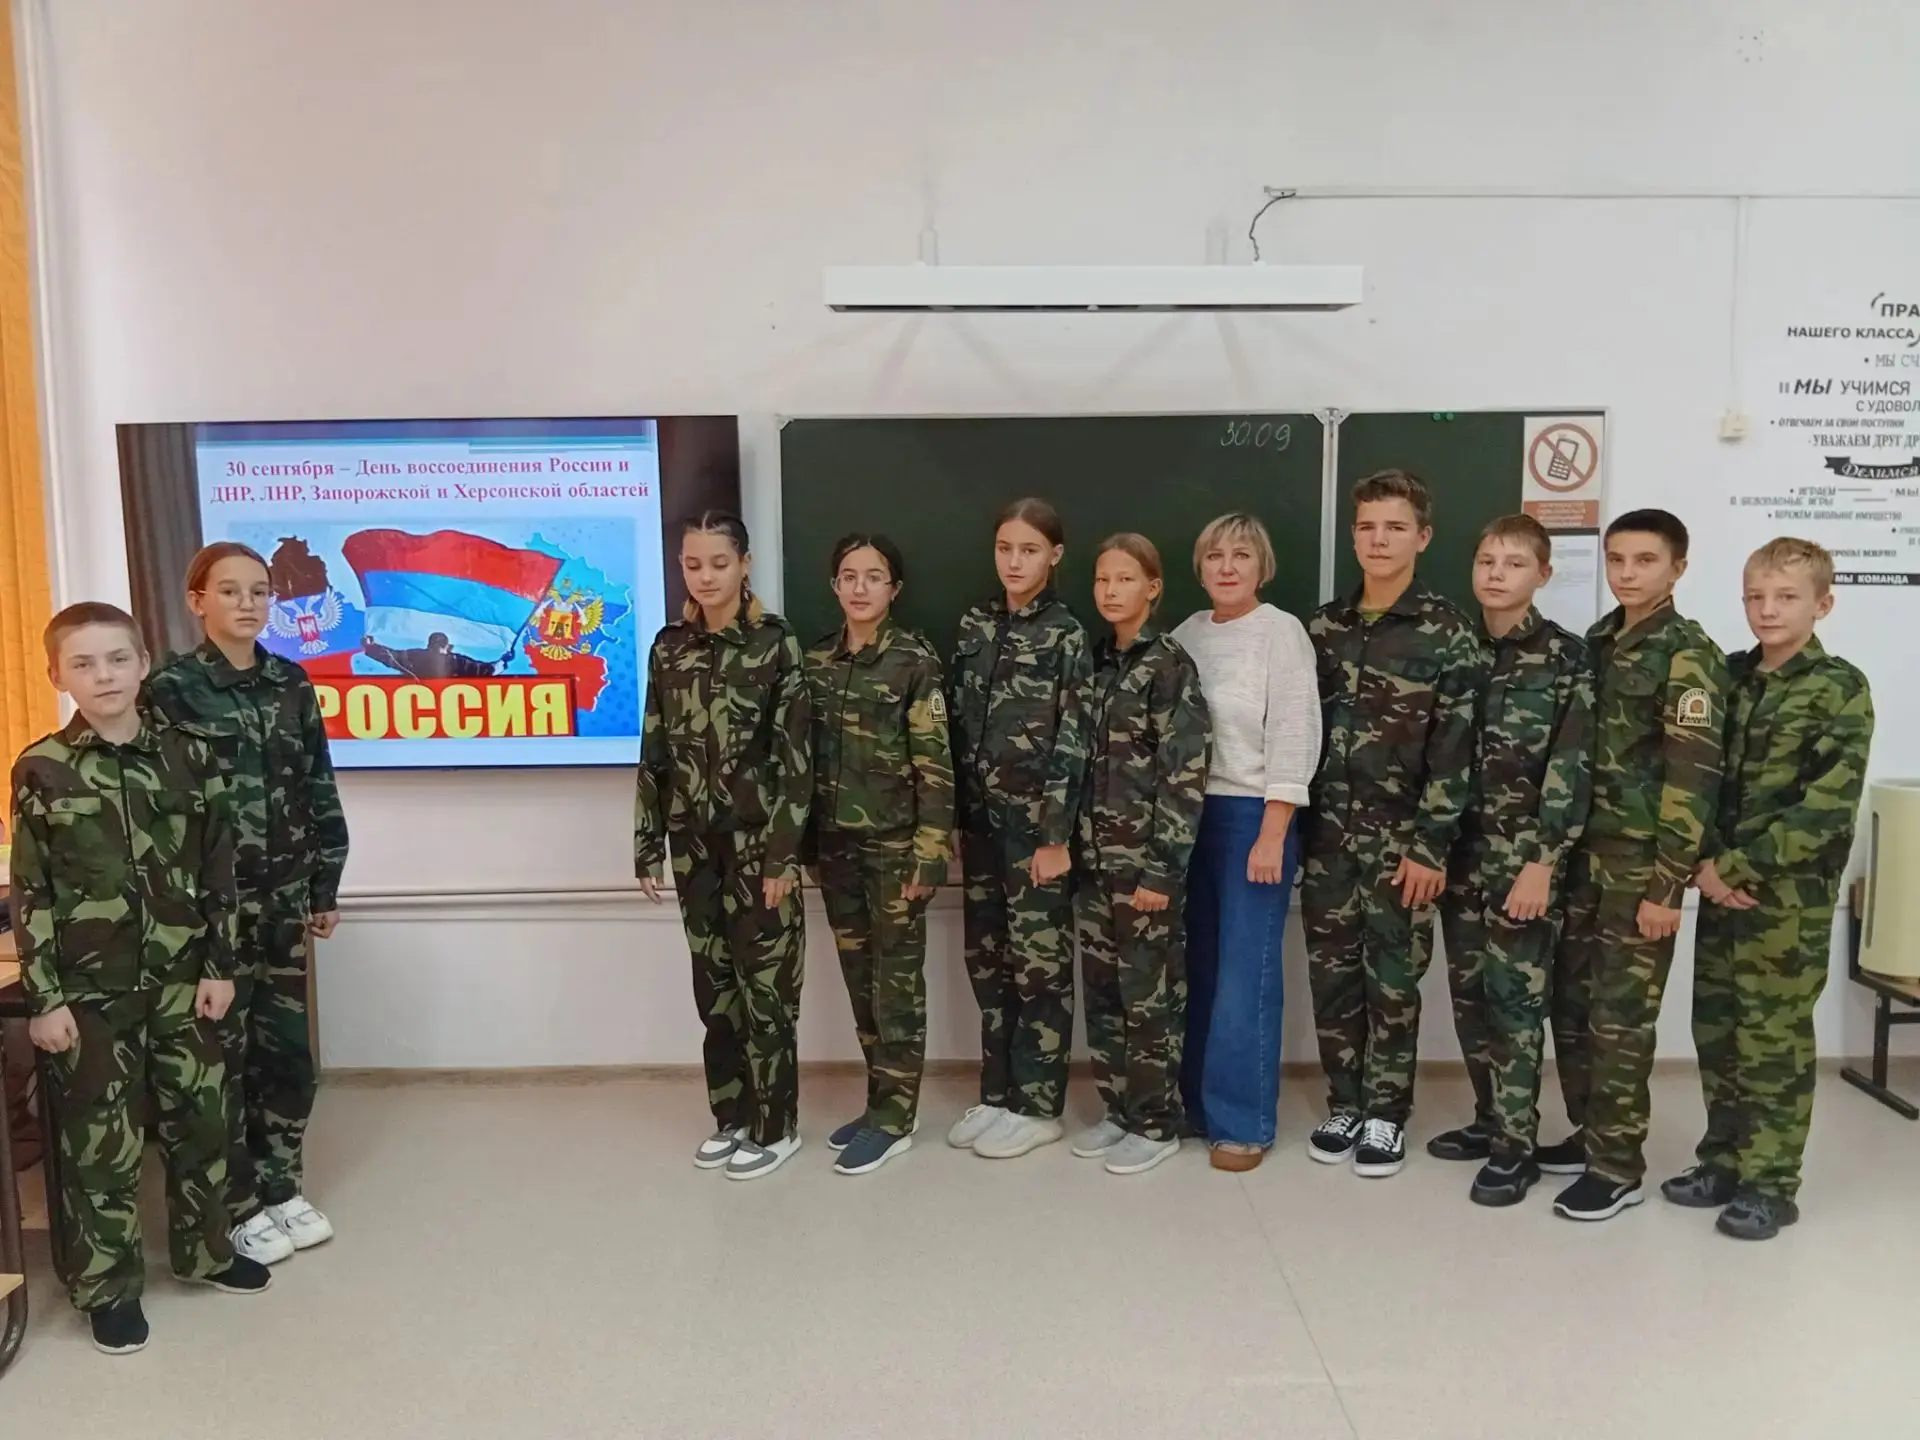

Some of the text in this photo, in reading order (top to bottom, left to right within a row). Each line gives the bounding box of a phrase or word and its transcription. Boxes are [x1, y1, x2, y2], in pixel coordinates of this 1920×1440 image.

[1880, 303, 1920, 318] ПРА
[1787, 326, 1915, 340] НАШЕГО КЛАССА
[1875, 354, 1896, 368] МЫ
[1793, 378, 1911, 396] МЫ УЧИМСЯ
[1856, 400, 1920, 414] С УДОВОЛ
[1812, 434, 1871, 448] УВАЖАЕМ
[1872, 434, 1903, 449] ДРУГ
[226, 461, 246, 477] 30
[251, 460, 335, 480] сентября
[356, 459, 402, 477] День
[407, 460, 543, 476] воссоединения
[549, 457, 613, 473] России
[618, 460, 629, 472] и
[210, 481, 649, 504] ДНР, ЛНР, Запорожской и Херсонской областей
[1834, 574, 1909, 584] МЫ КОМАНДА
